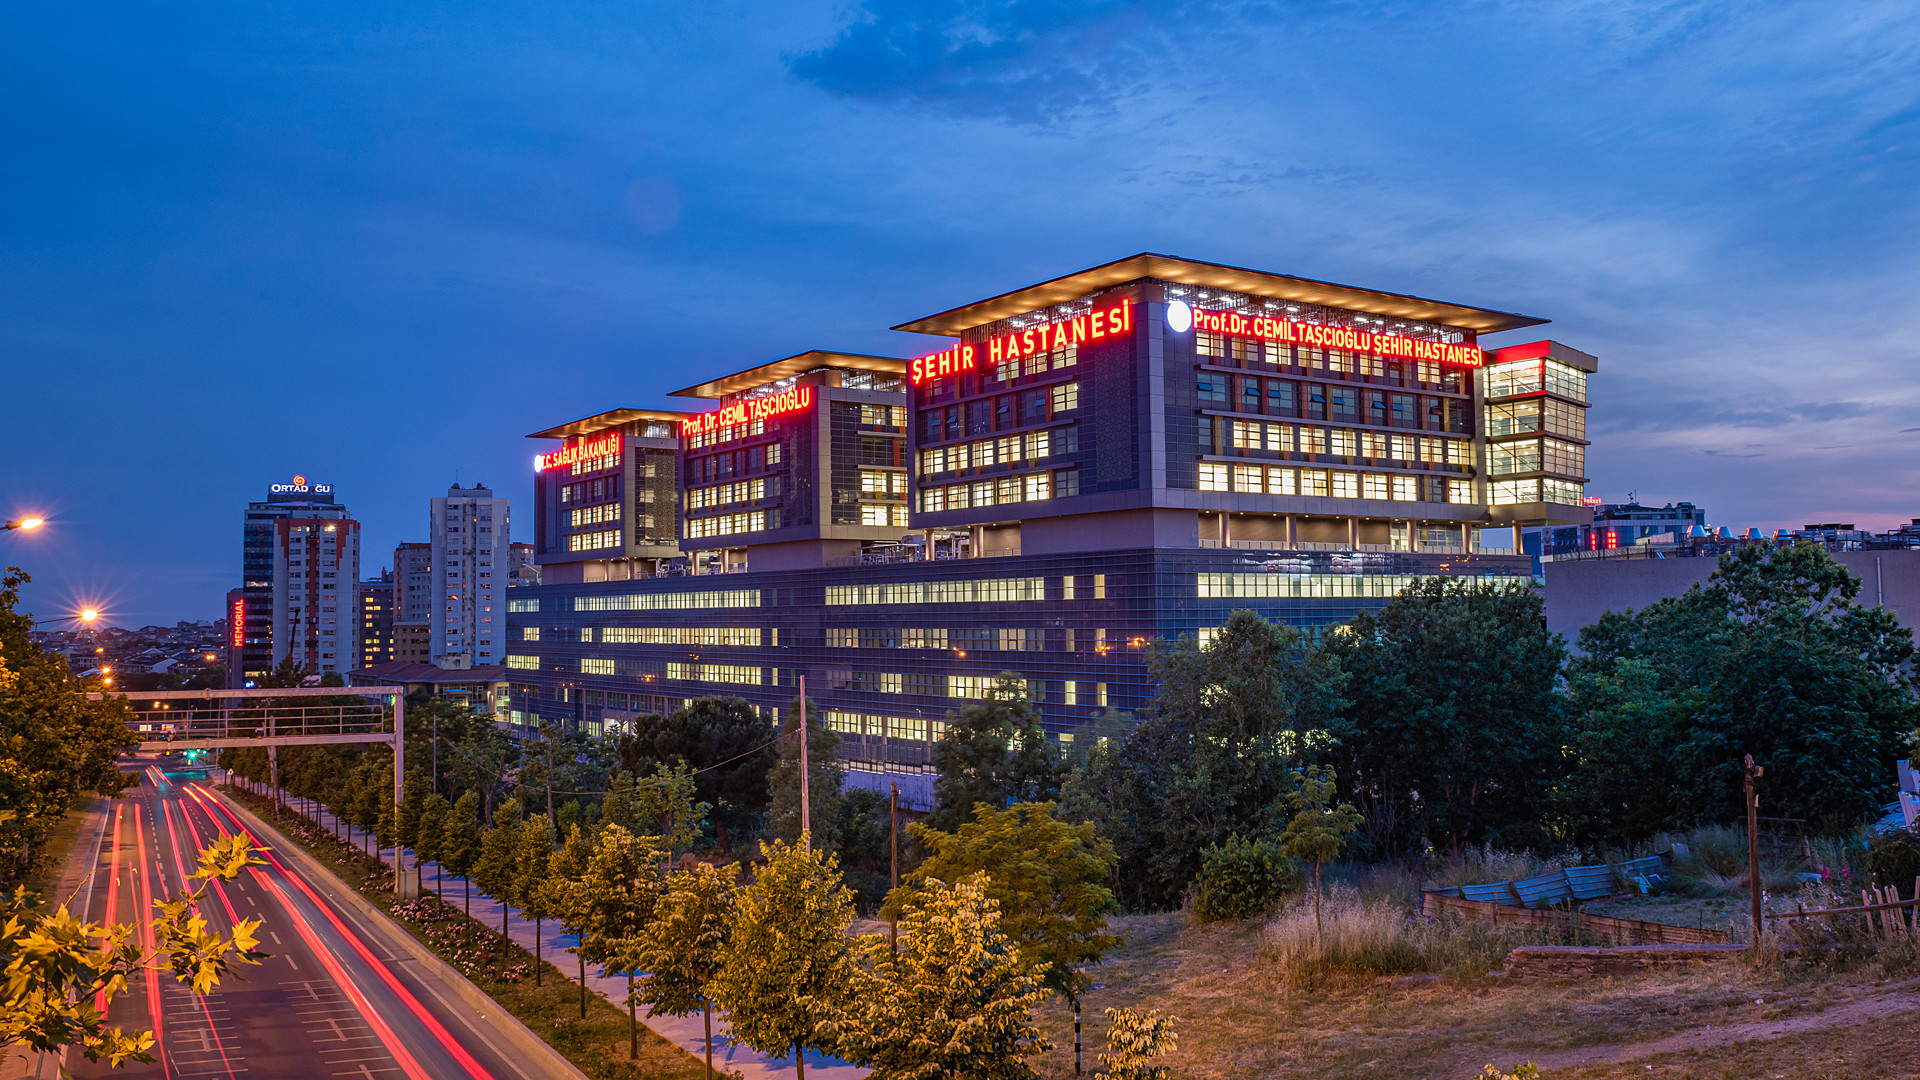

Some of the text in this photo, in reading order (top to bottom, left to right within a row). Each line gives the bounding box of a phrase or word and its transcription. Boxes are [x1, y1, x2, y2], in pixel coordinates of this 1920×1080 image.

[912, 299, 1130, 384] ŞEHİR HASTANESİ
[1253, 317, 1296, 341] CEMİL
[1296, 322, 1371, 350] TAŞCIOĞLU
[1373, 334, 1413, 357] ŞEHİR
[1415, 340, 1483, 366] HASTANESİ
[682, 415, 703, 436] Prof.
[704, 412, 718, 431] Dr.
[719, 400, 748, 426] CEMİL
[553, 446, 578, 467] SAĞLIK
[234, 599, 244, 647] MEMORIAL
